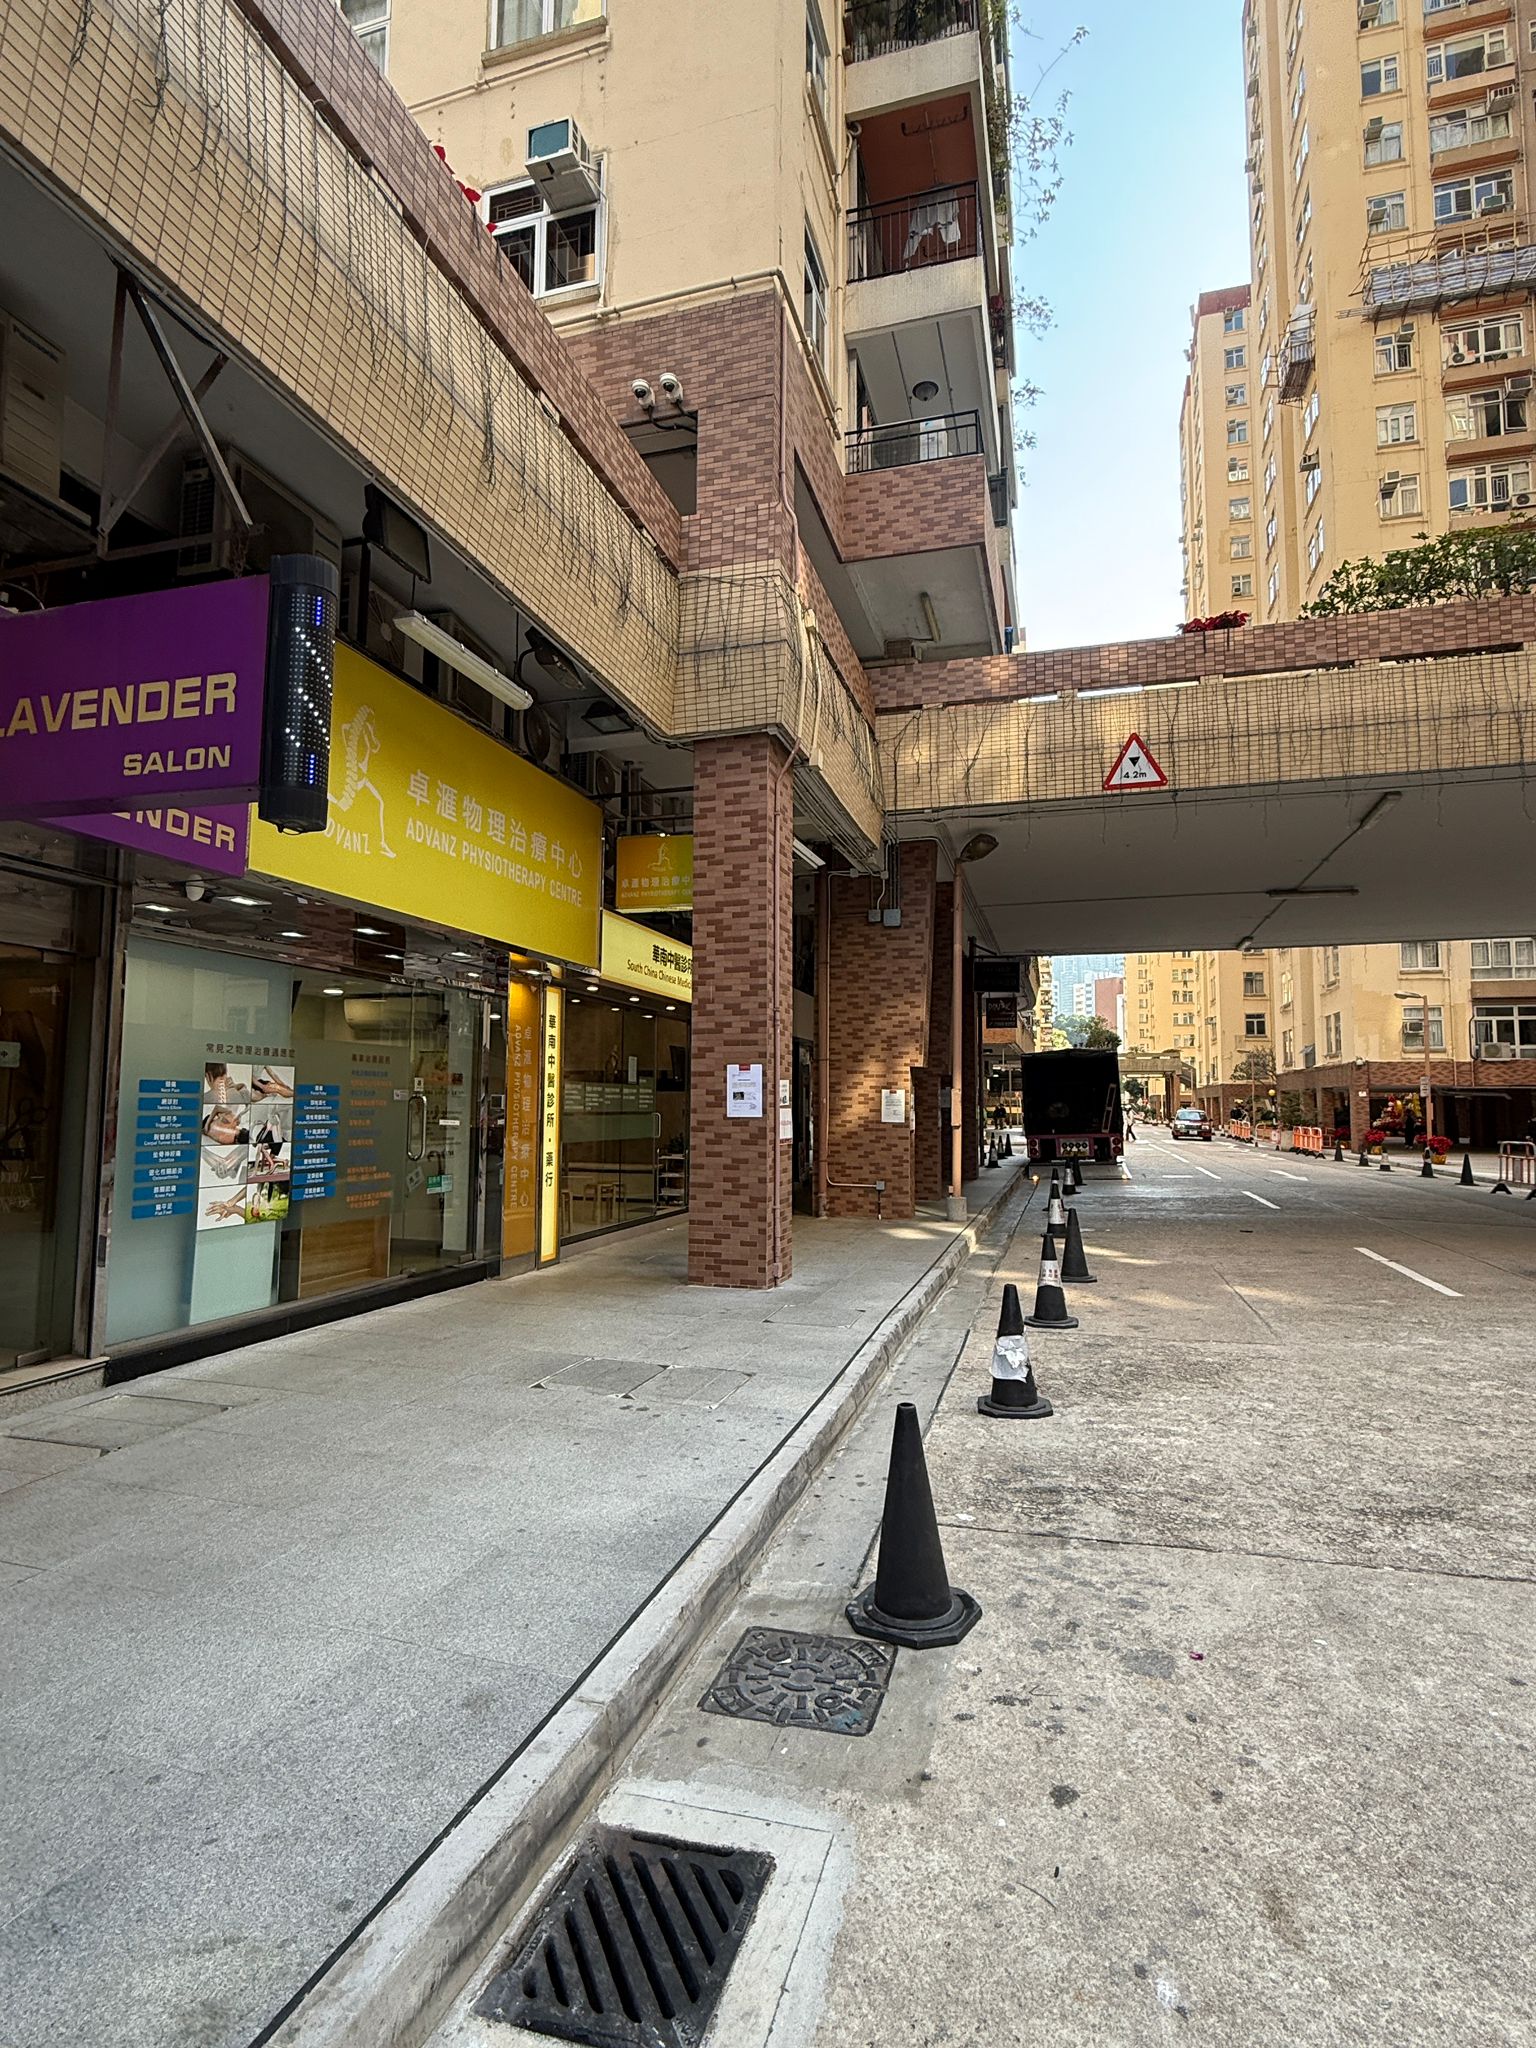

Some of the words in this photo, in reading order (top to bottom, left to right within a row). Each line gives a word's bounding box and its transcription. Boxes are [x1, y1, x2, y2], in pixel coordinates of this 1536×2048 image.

[123, 745, 231, 776] SALON
[1123, 771, 1147, 779] 4.2m
[111, 808, 235, 852] NDER
[324, 817, 371, 855] DVANZ
[406, 816, 457, 857] ADVANZ
[462, 840, 547, 892] PHYSIOTHERAPY
[549, 879, 583, 907] CENTRE
[627, 959, 643, 974] South
[643, 965, 658, 979] China
[658, 970, 677, 984] Chinese
[513, 1024, 522, 1067] ADVANZ
[511, 1072, 521, 1160] PHYSIOTHERAPY
[510, 1165, 518, 1209] CENTRE
